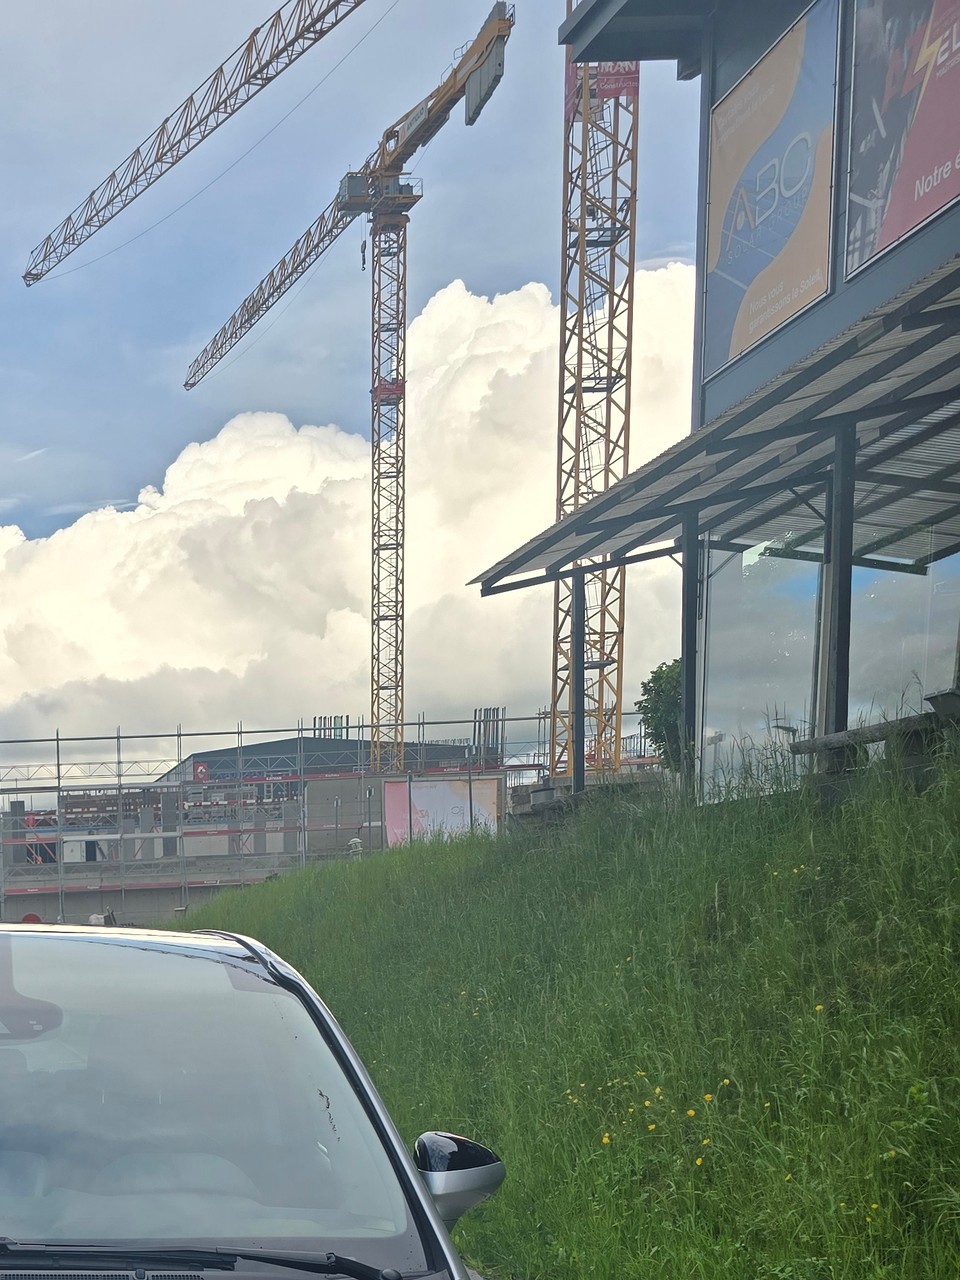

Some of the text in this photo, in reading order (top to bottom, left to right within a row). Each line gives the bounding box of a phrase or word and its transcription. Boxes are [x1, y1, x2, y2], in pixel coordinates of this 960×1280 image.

[726, 131, 812, 251] ABC
[915, 161, 952, 201] Notre
[749, 281, 784, 315] Nous vous
